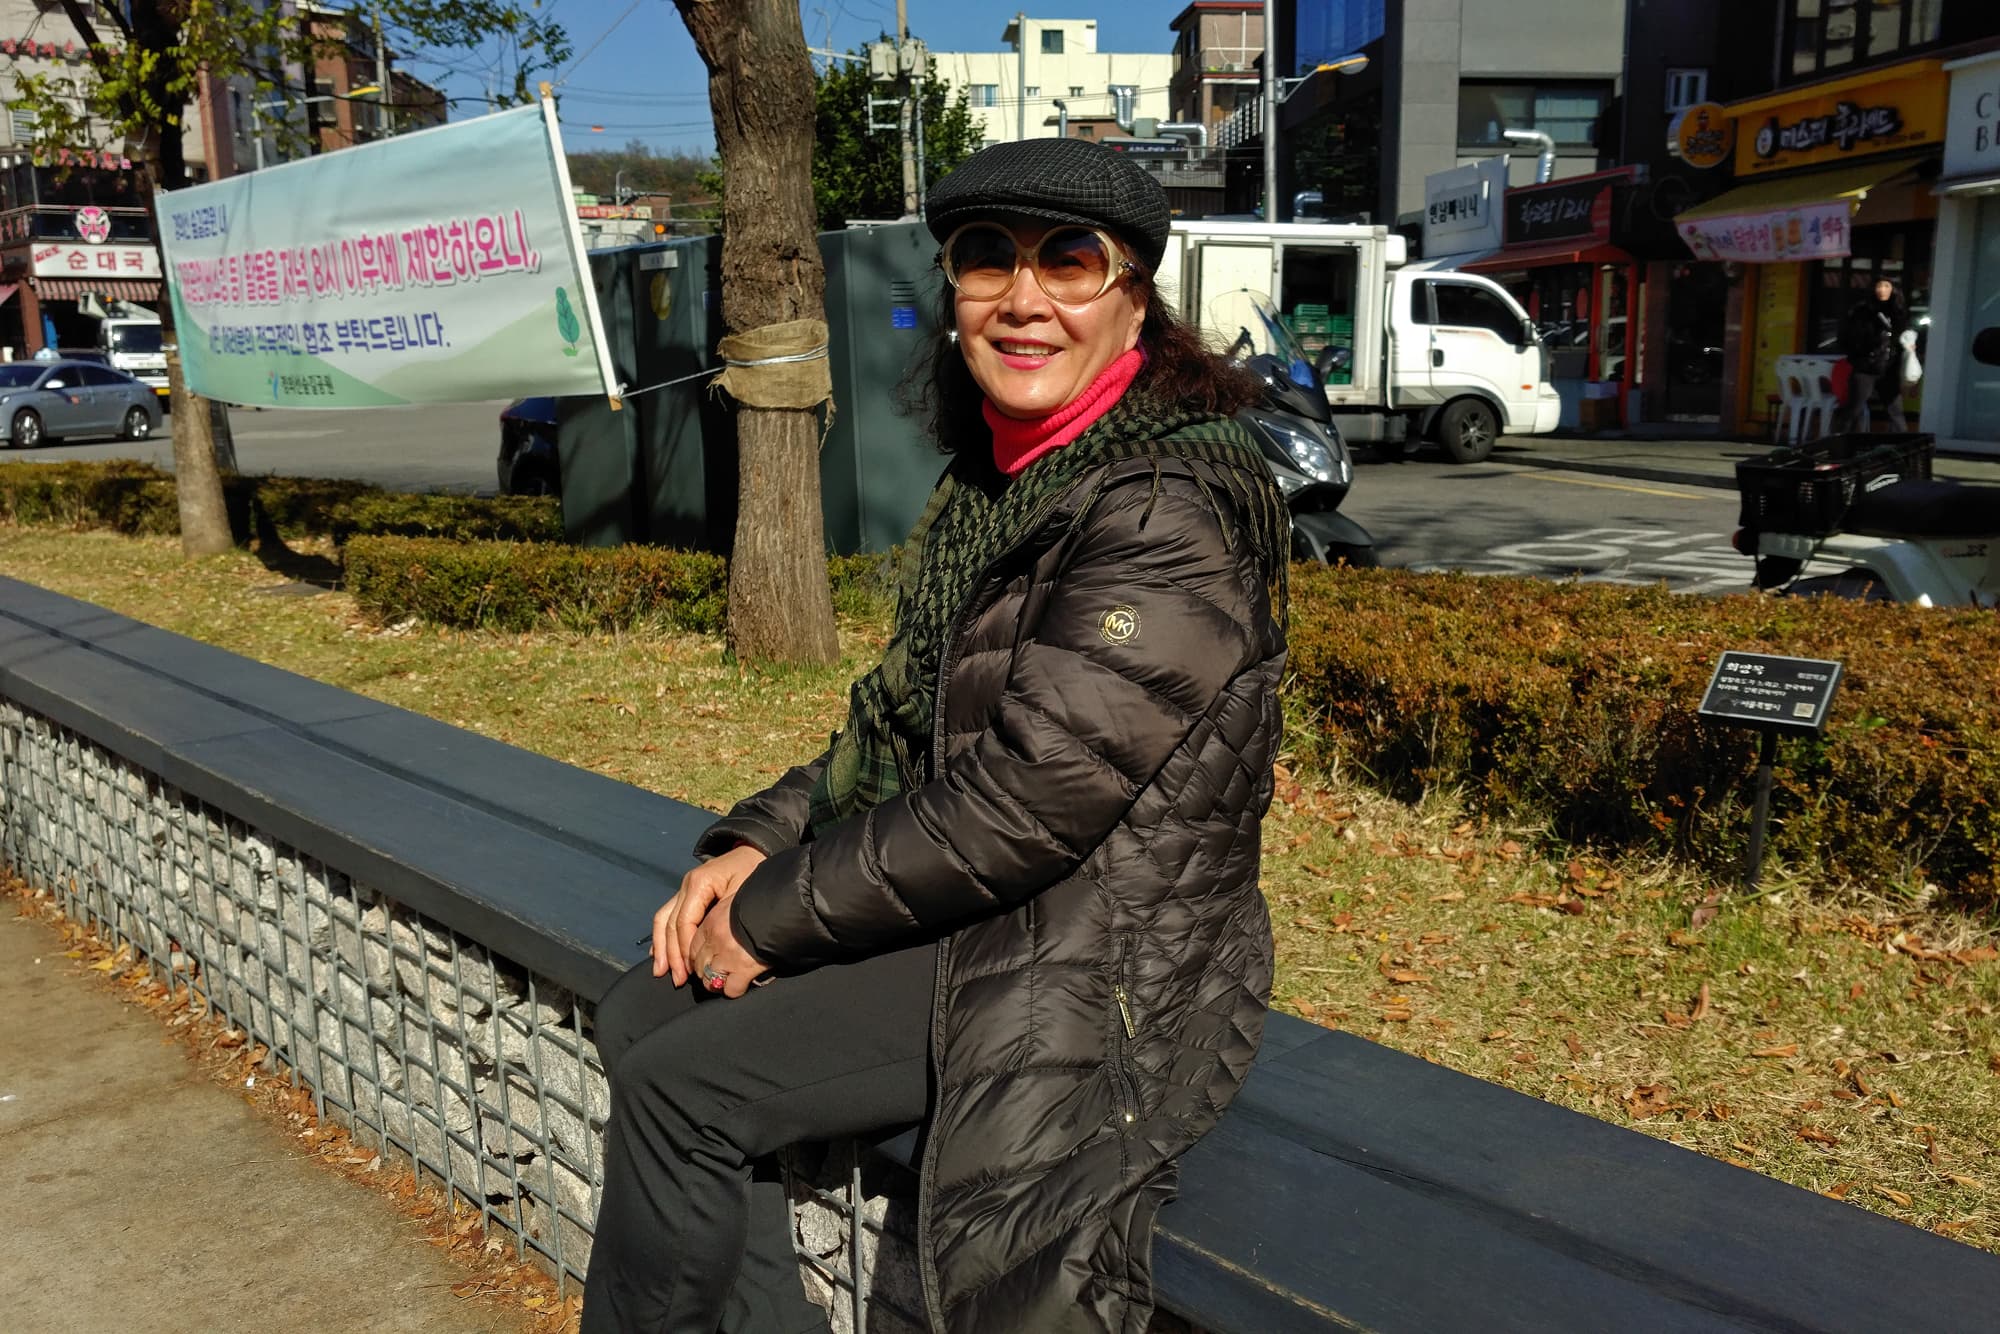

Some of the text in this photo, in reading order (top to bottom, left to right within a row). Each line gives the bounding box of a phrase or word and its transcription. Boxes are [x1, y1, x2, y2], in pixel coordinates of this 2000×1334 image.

[66, 249, 144, 272] 순대국
[243, 249, 281, 301] 활동을
[279, 246, 312, 297] 저녁
[311, 240, 342, 294] 8시
[341, 232, 401, 291] 이후에
[401, 208, 539, 282] 제한하오니,
[302, 321, 335, 355] 협조
[335, 311, 452, 354] 부탁드립니다.
[1104, 610, 1135, 640] MK
